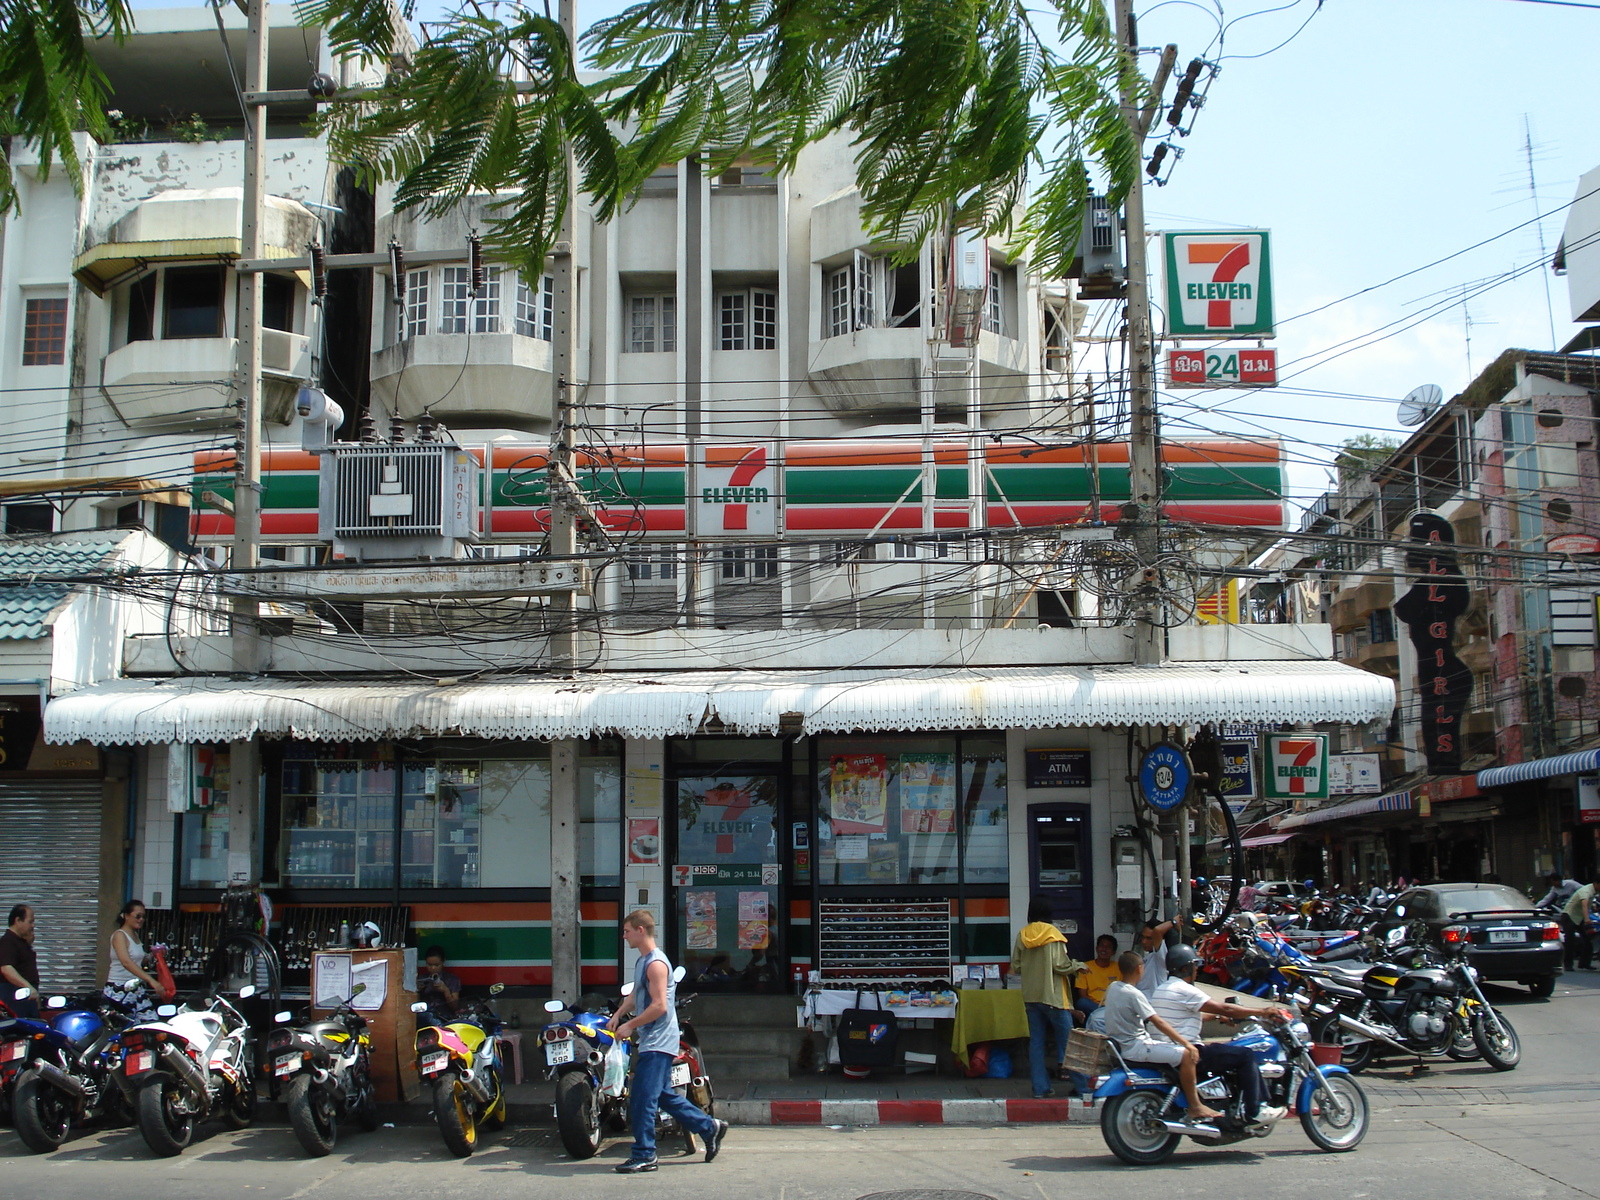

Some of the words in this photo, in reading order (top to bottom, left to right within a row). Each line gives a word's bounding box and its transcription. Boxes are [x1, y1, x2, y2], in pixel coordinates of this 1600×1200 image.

[1188, 242, 1250, 327] 7
[1174, 355, 1202, 373] เปิด
[1206, 354, 1239, 378] 24
[705, 446, 767, 530] 7
[1048, 763, 1071, 773] ATM
[1279, 740, 1316, 793] 7
[1157, 771, 1171, 785] 13/4
[1152, 786, 1179, 798] PATTAYA
[675, 866, 690, 885] 7
[552, 1055, 568, 1064] 592
